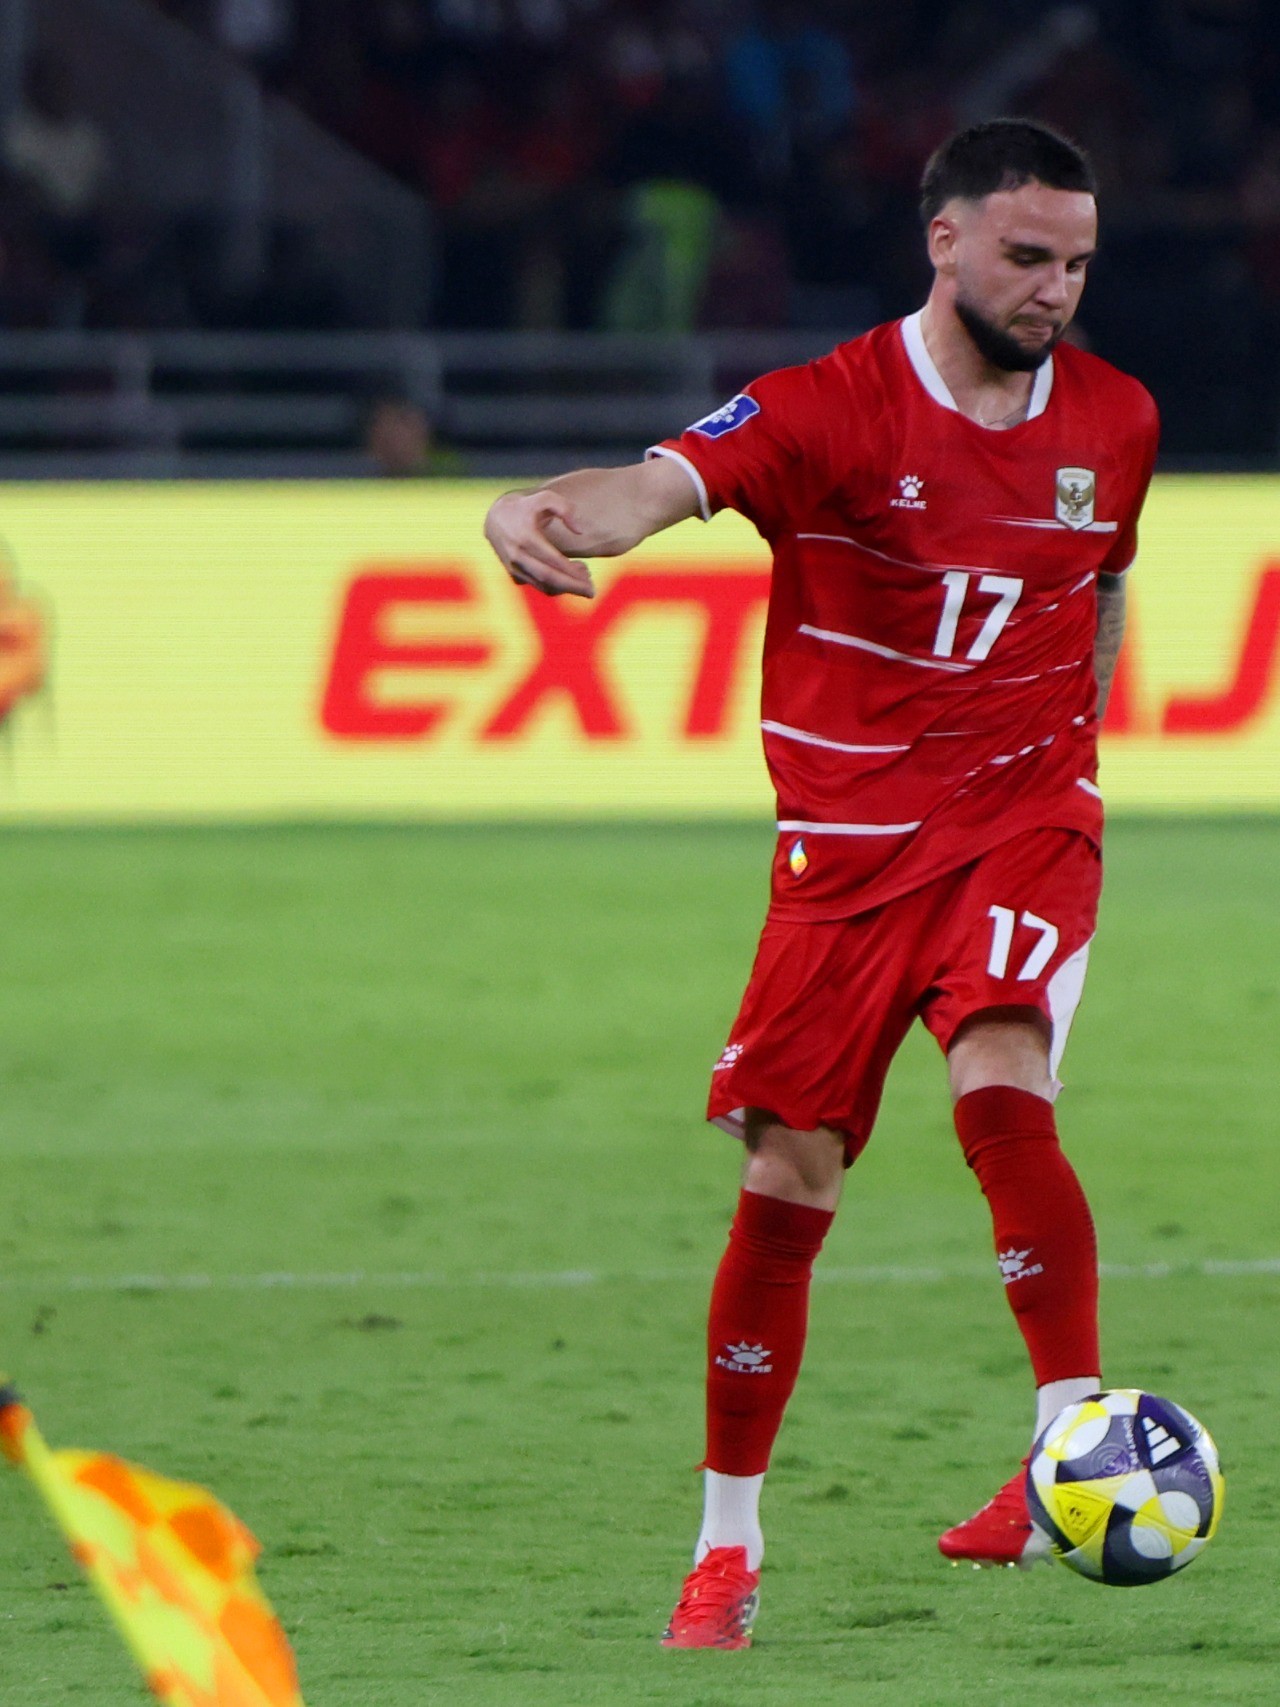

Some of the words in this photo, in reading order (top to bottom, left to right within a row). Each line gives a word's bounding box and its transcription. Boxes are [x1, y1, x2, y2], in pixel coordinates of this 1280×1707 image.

[889, 498, 928, 510] KELME
[931, 570, 1024, 661] 17
[986, 904, 1059, 982] 17
[714, 1354, 773, 1374] KELME
